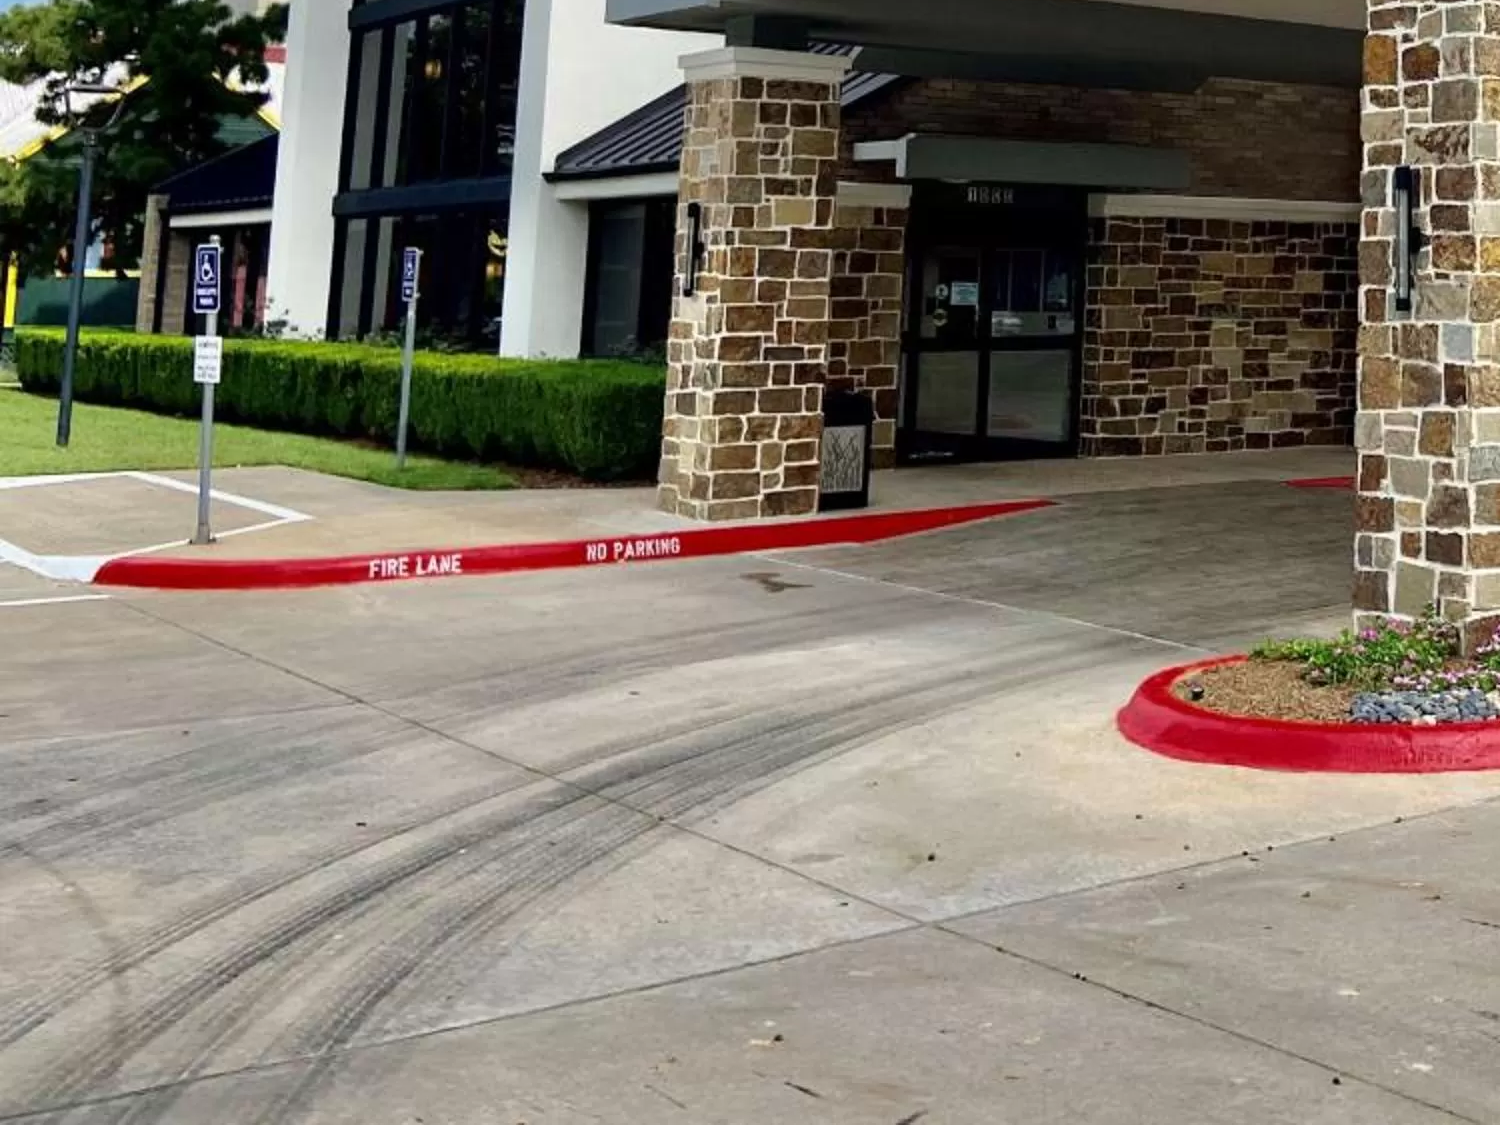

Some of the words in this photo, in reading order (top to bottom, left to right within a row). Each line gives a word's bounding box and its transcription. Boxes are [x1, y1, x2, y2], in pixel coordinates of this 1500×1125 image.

[586, 543, 607, 561] NO
[613, 537, 681, 560] PARKING
[369, 556, 410, 579] FIRE
[416, 553, 463, 576] LANE
